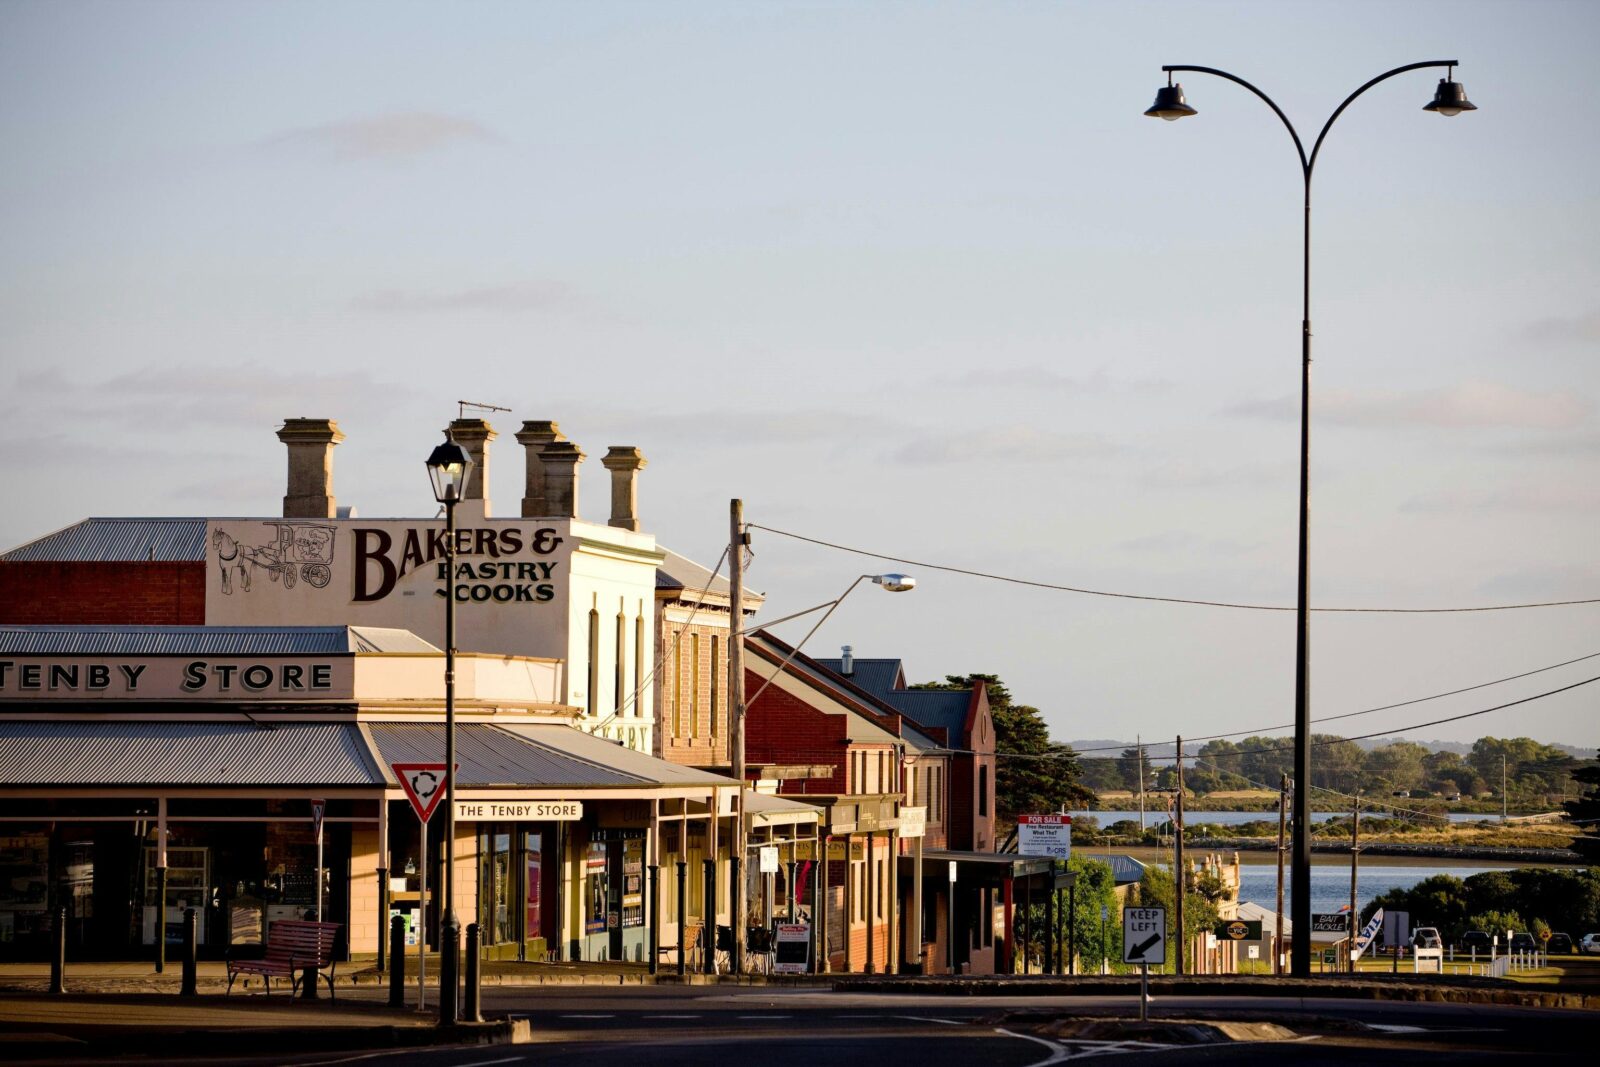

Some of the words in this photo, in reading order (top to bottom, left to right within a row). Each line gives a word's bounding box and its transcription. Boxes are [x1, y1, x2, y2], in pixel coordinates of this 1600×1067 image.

[352, 528, 523, 602] BAKERS
[532, 528, 563, 554] &
[184, 662, 332, 689] STORE
[460, 805, 483, 816] THE
[490, 805, 531, 816] TENBY
[537, 804, 577, 816] STORE
[1130, 910, 1159, 920] KEEP
[1319, 915, 1340, 923] BAIT
[1131, 922, 1157, 932] LEFT
[1313, 922, 1344, 931] TACKLE
